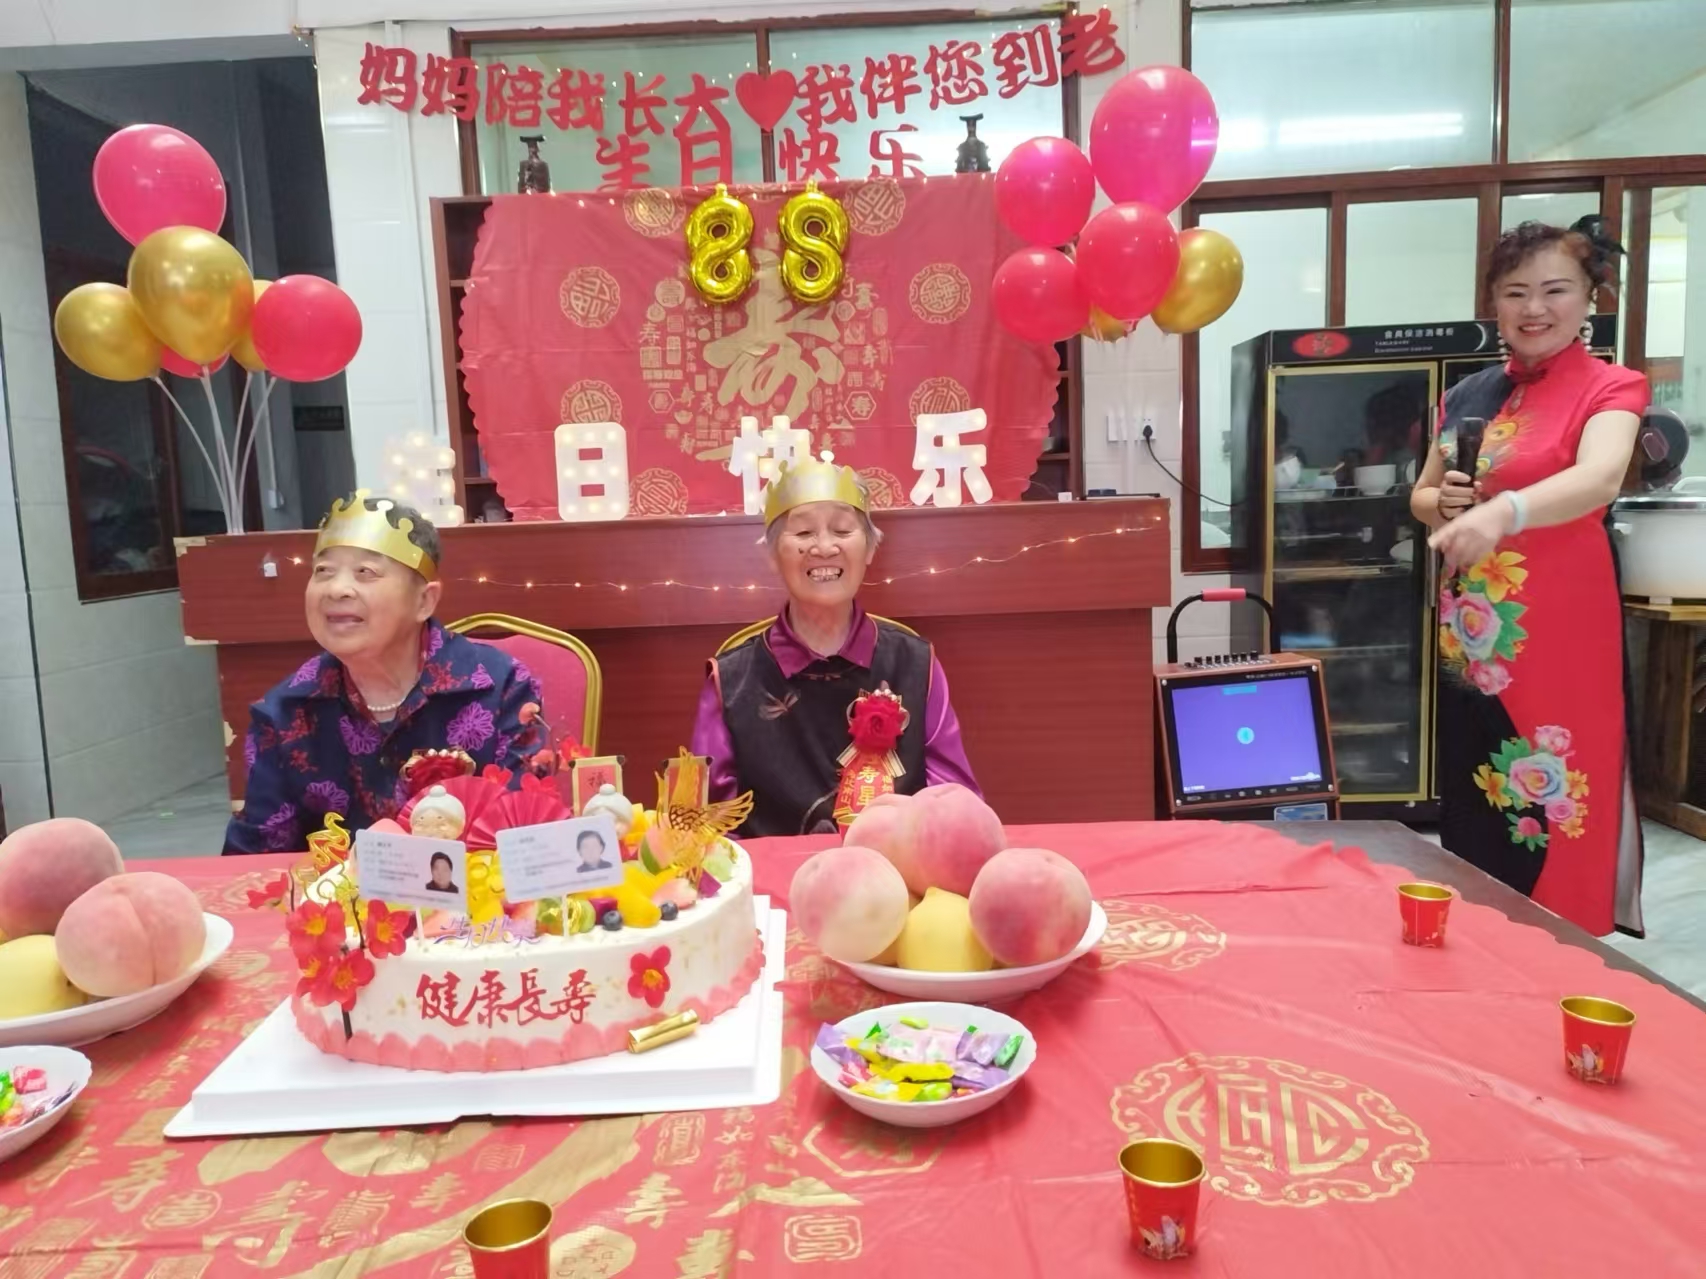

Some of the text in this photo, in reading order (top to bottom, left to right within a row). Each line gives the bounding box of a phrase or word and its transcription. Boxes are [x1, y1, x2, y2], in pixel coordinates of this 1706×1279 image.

[357, 8, 1125, 137] 妈妈陪我长大 我伴您到老
[595, 124, 927, 191] 生日快乐
